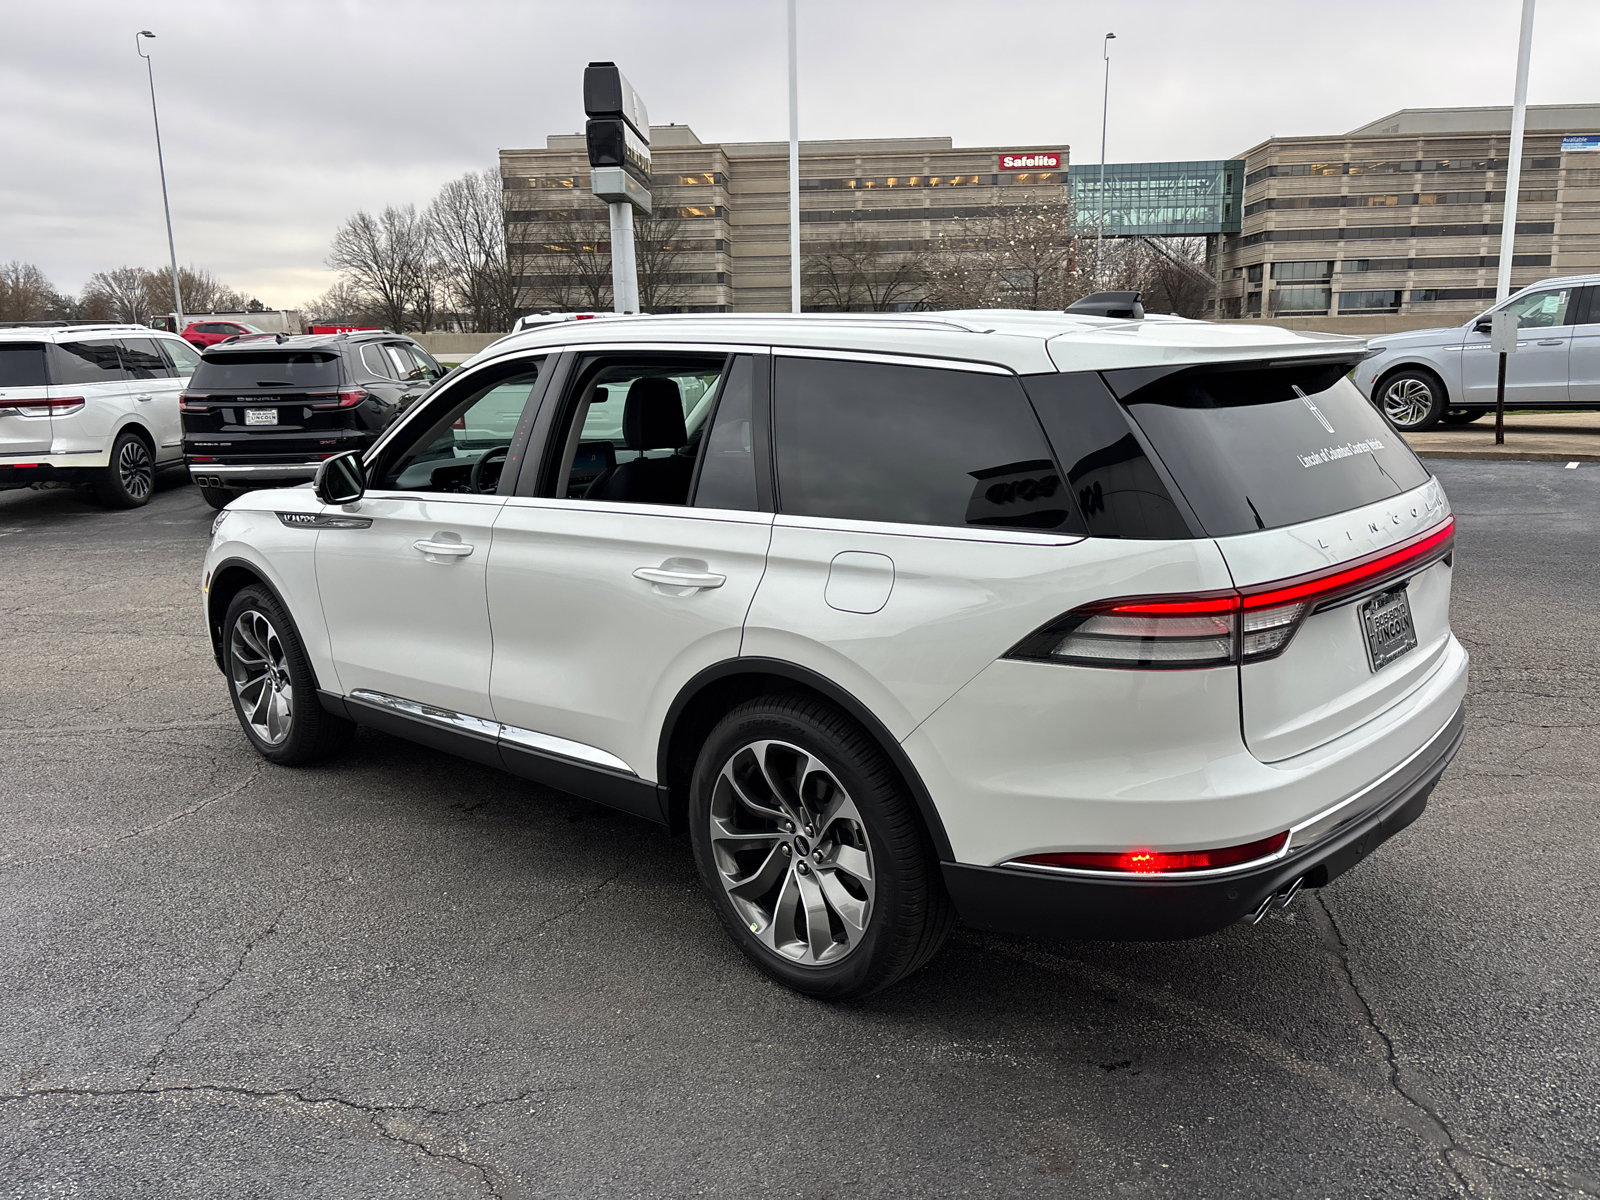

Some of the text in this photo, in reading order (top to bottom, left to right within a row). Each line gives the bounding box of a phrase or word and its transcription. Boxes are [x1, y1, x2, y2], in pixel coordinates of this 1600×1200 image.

[1003, 155, 1057, 168] Safelite
[1317, 497, 1442, 549] LINCOLN
[1374, 615, 1410, 644] LINCOLN
